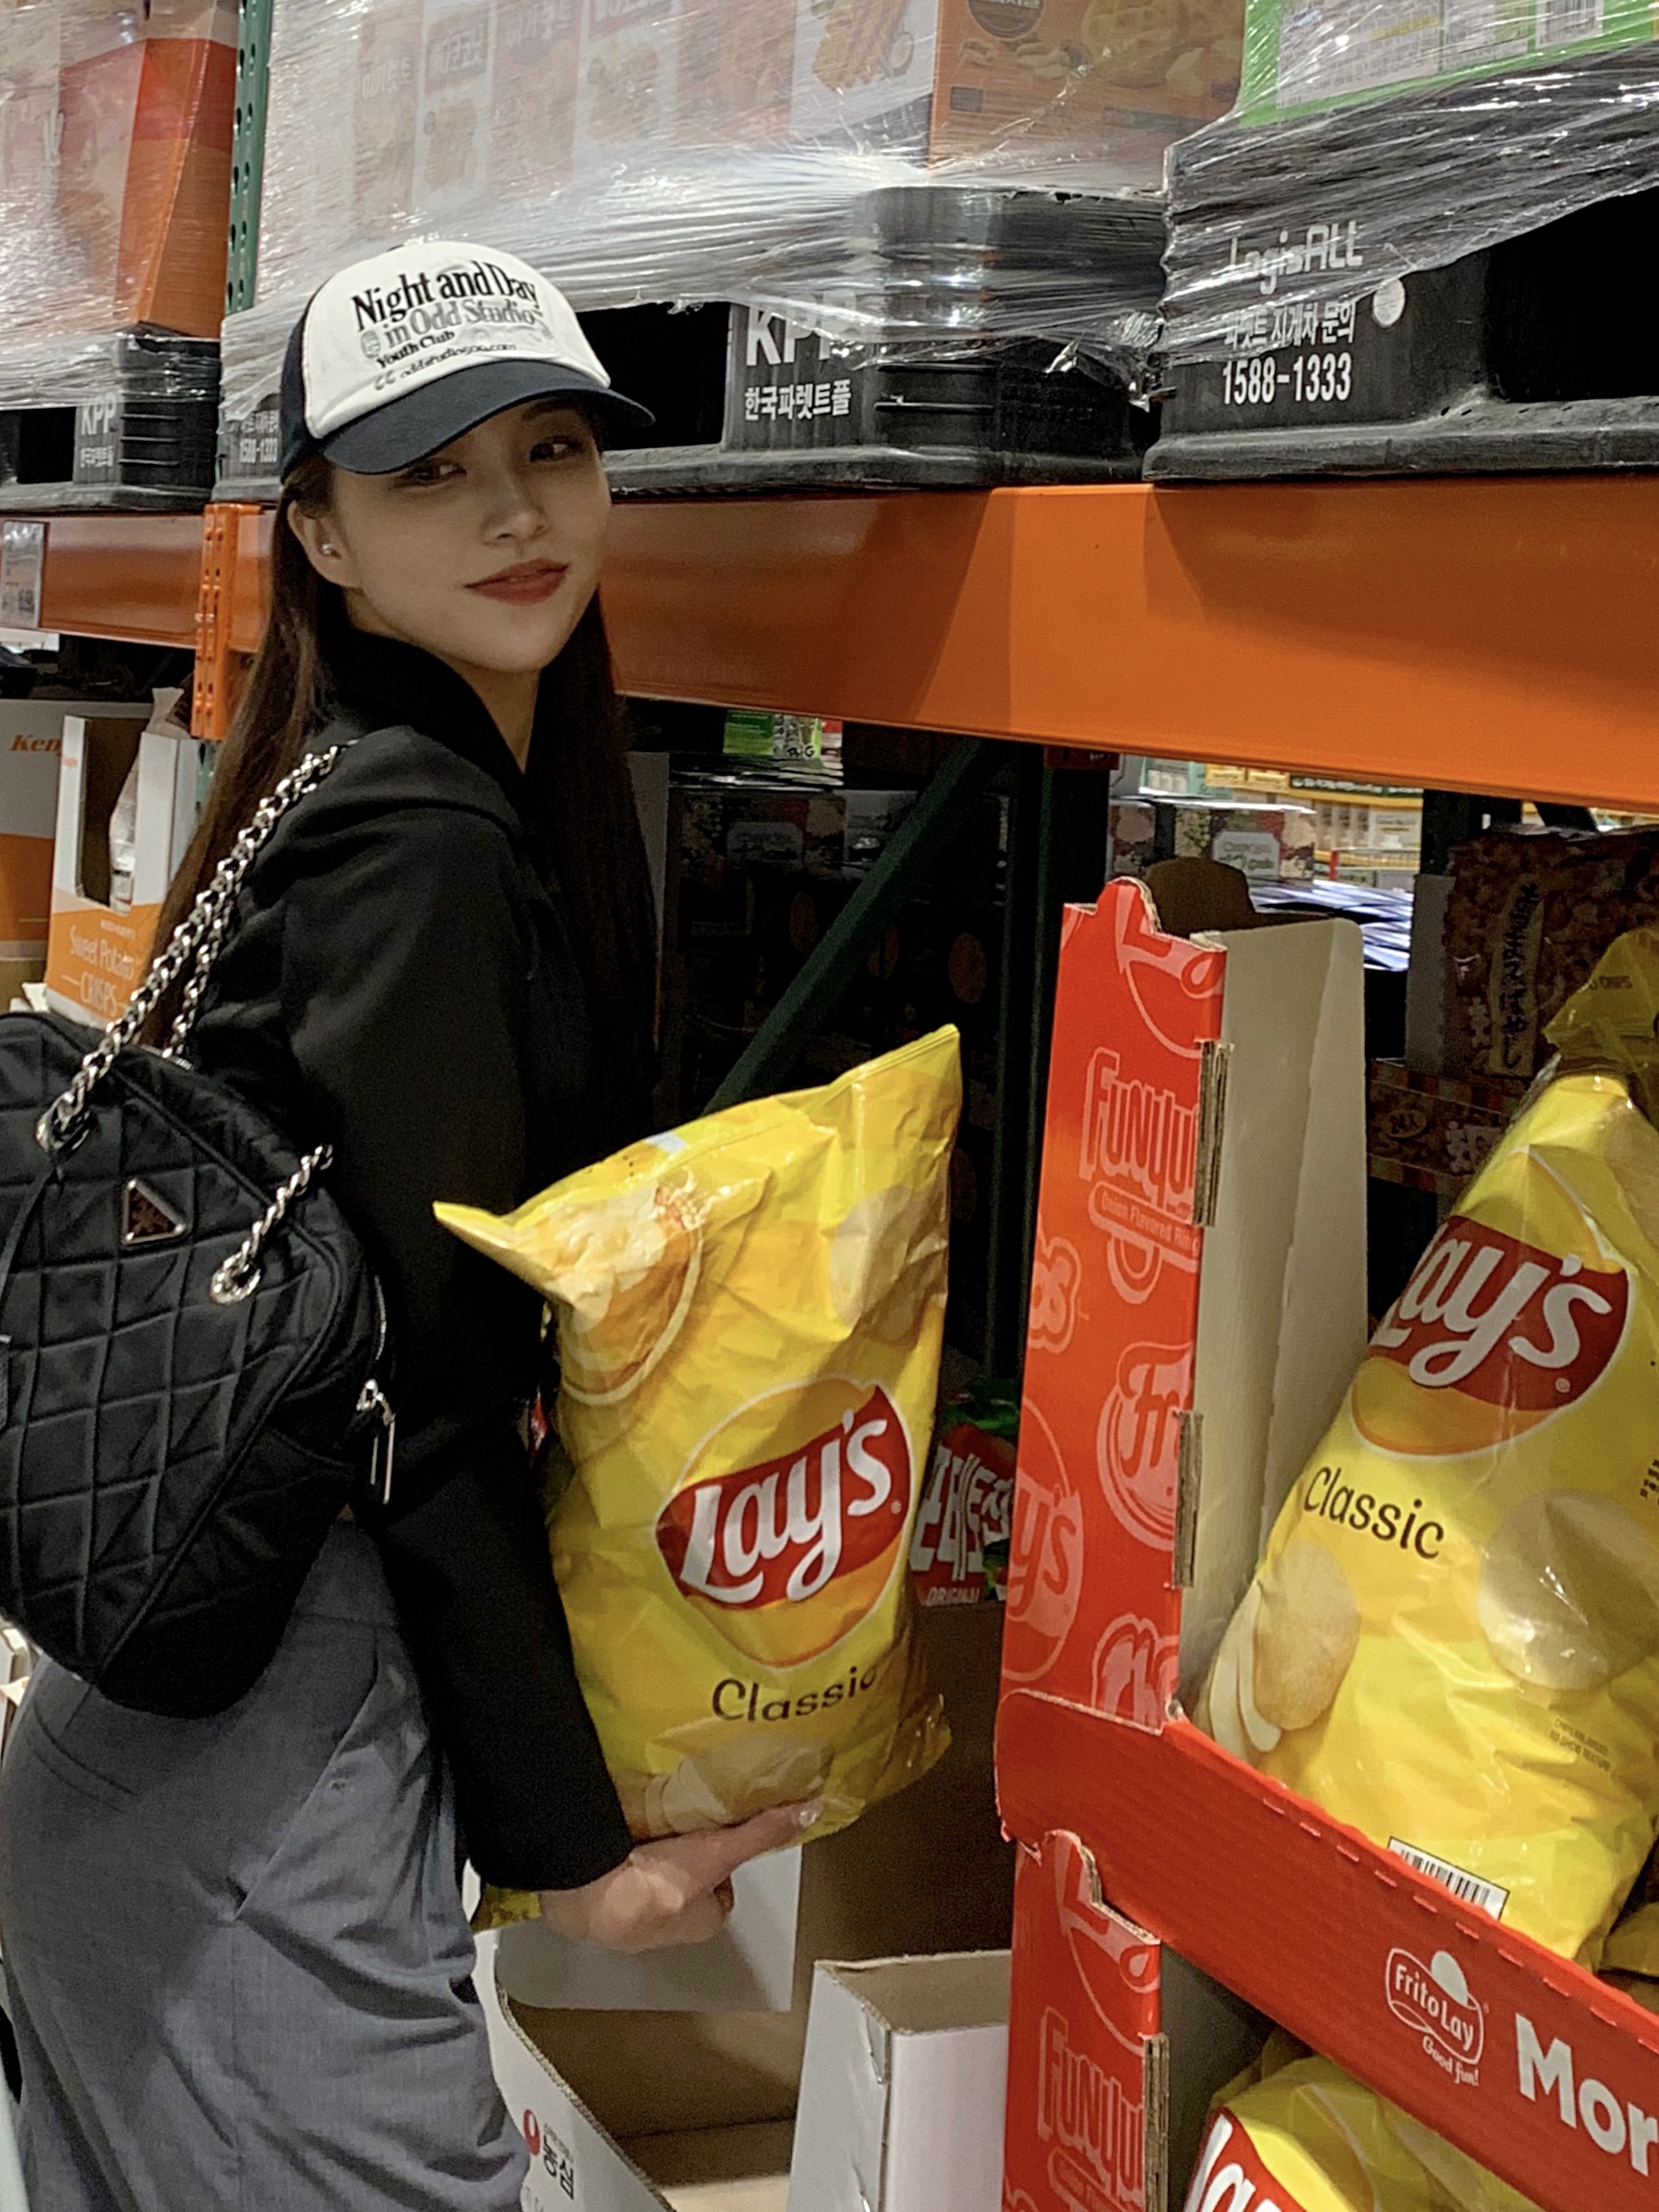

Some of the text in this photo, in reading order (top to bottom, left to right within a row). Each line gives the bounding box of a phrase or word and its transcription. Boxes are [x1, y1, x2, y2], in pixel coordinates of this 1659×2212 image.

[351, 261, 540, 332] Night and Day
[1321, 299, 1356, 344] 문의
[376, 330, 456, 368] Youth Club
[384, 298, 537, 348] in Odd Studio
[1222, 352, 1352, 405] 1588-1333
[80, 393, 117, 435] KPP
[11, 733, 62, 757] Ken
[680, 1409, 891, 1604] Lay's
[1304, 1466, 1445, 1559] Classic
[712, 1665, 879, 1723] Classic
[1422, 2035, 1479, 2087] Good fun!
[1187, 2114, 1283, 2212] La
